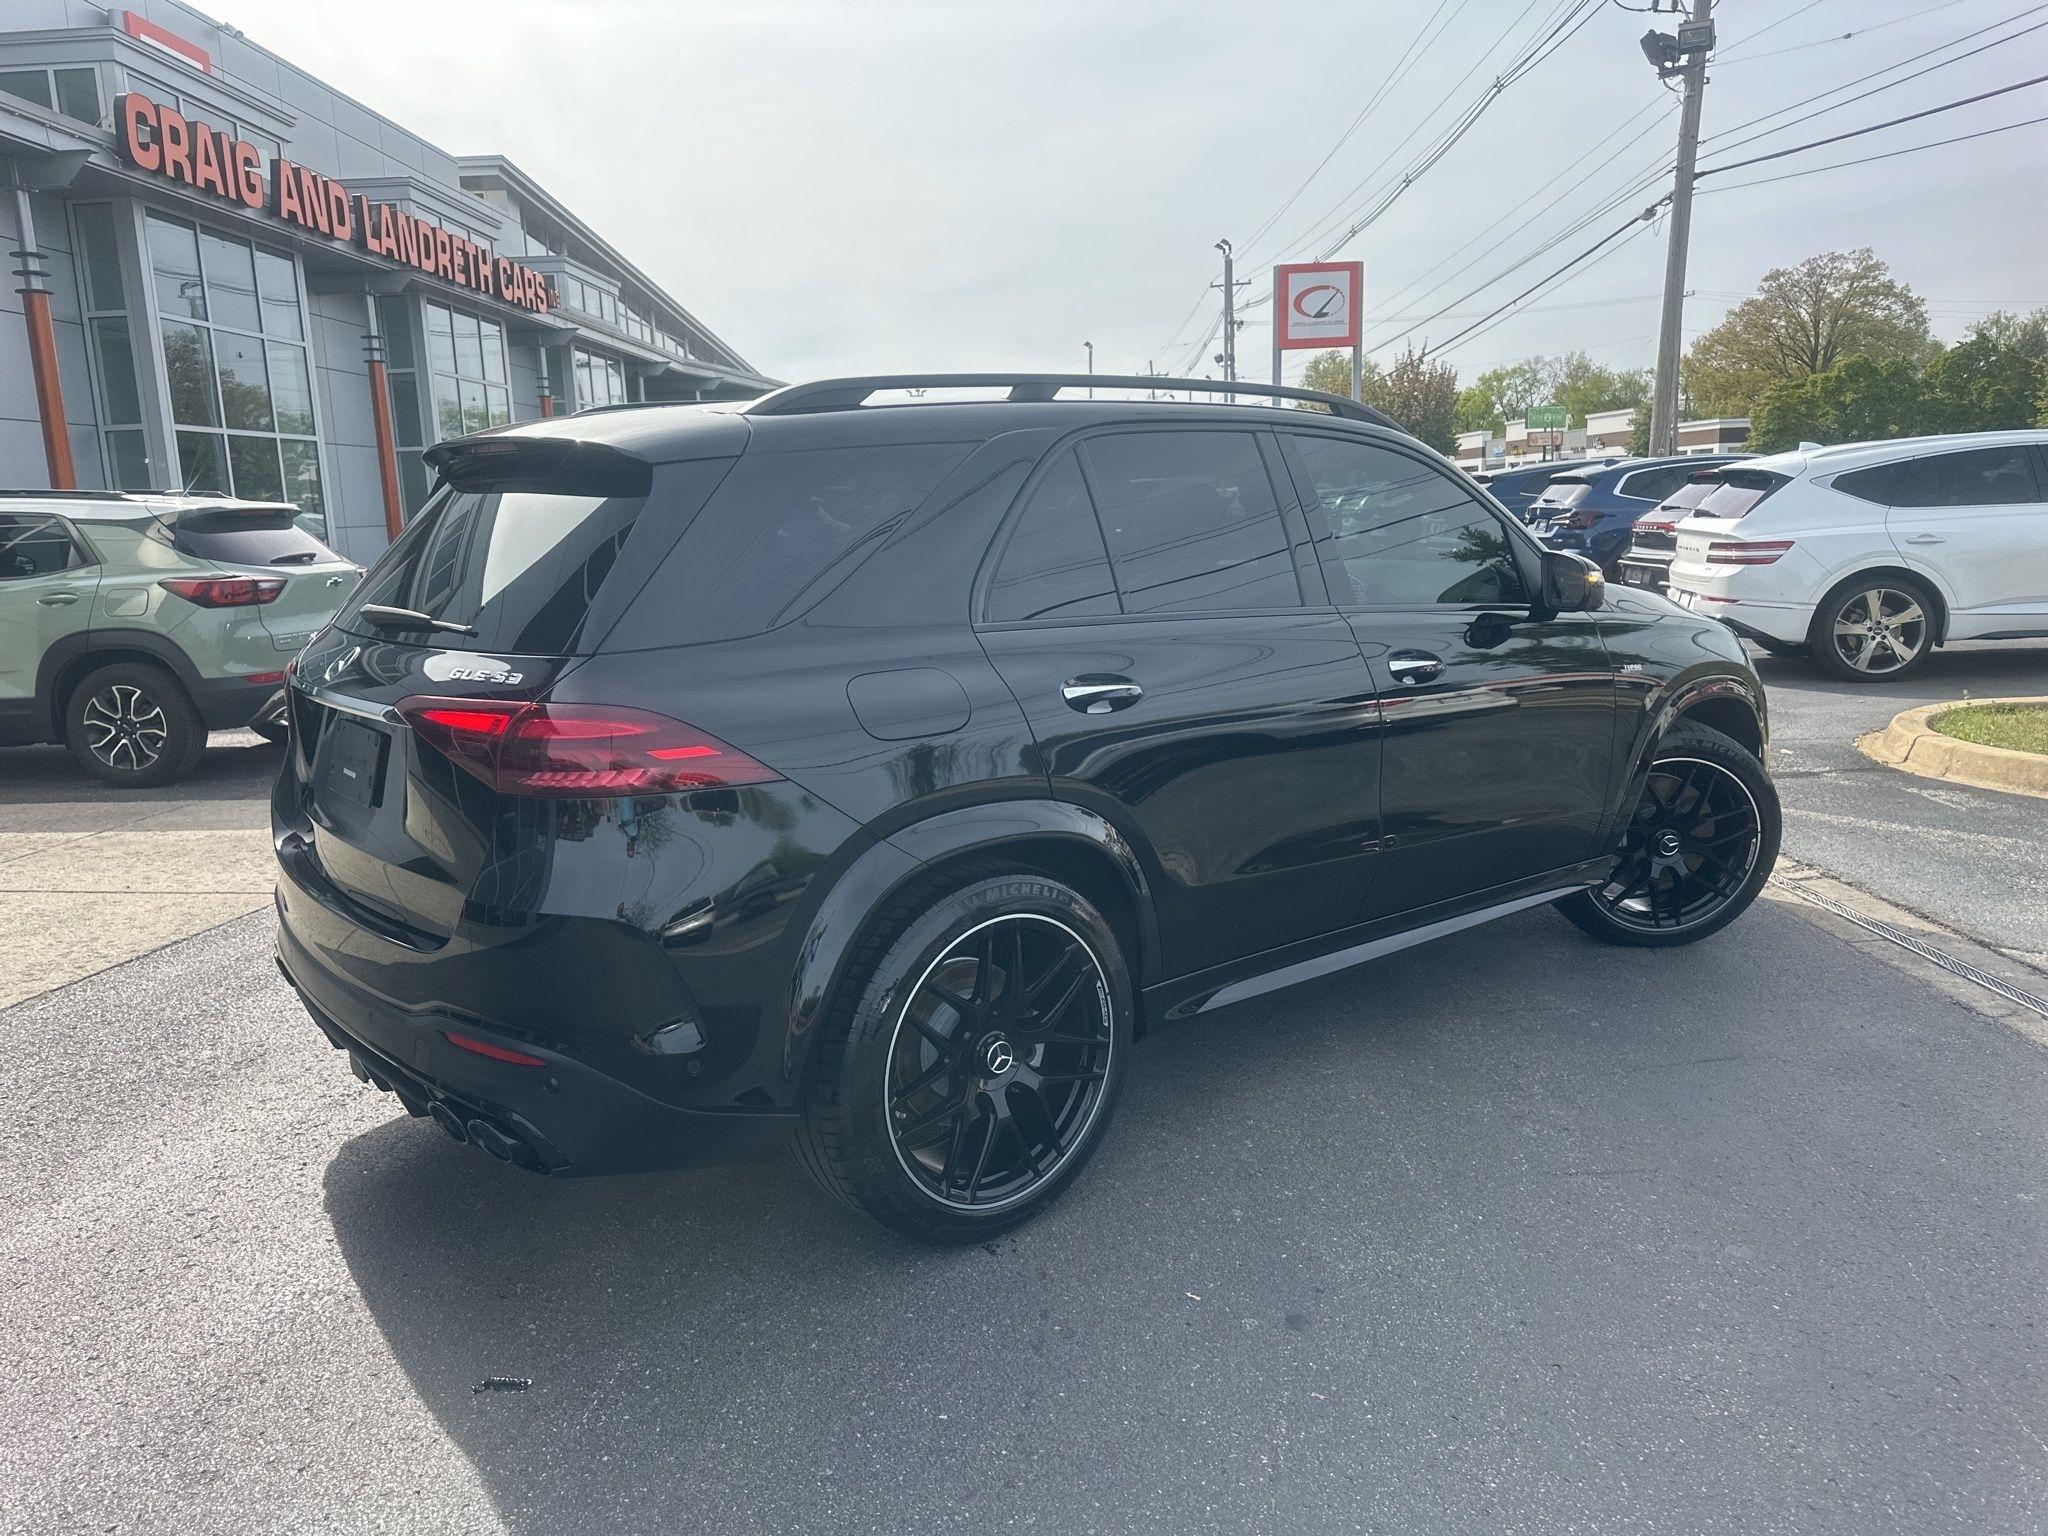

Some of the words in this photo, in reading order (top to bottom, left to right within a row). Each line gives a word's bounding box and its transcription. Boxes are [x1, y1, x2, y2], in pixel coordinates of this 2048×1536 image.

[123, 91, 264, 208] CRAIG
[279, 159, 352, 241] AND
[360, 195, 494, 294] LANDRETH
[498, 256, 548, 313] CARS
